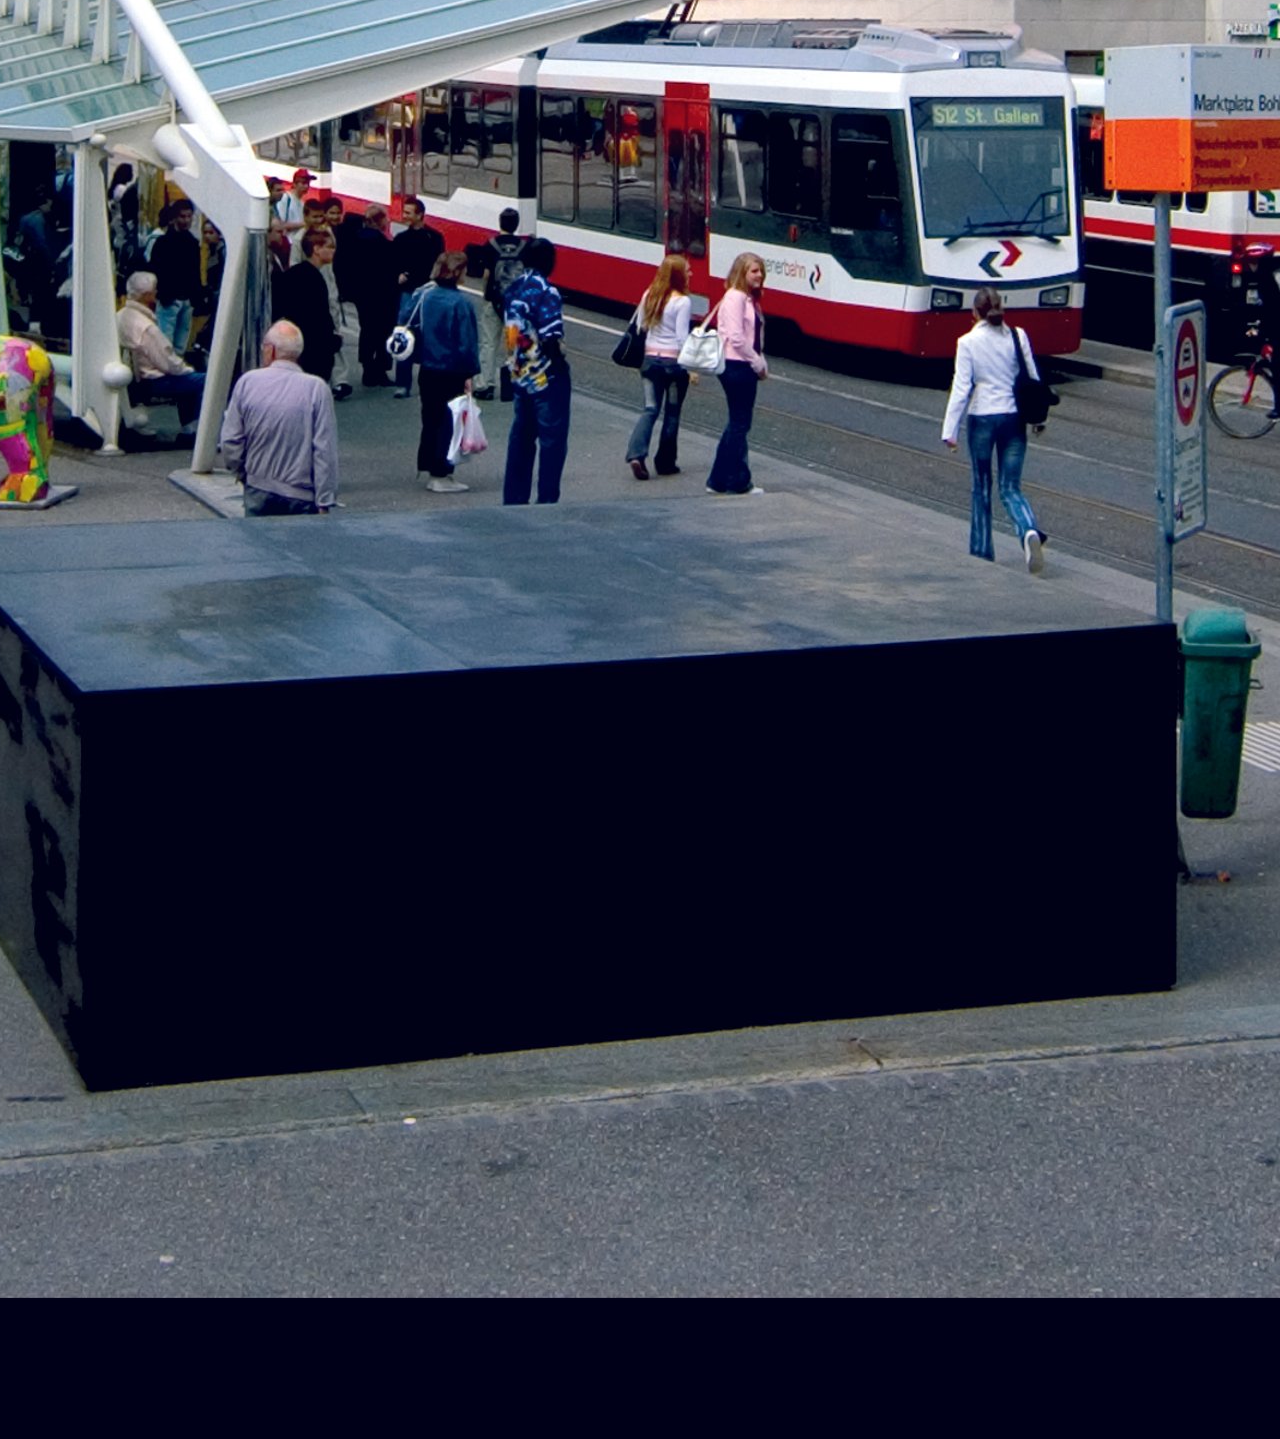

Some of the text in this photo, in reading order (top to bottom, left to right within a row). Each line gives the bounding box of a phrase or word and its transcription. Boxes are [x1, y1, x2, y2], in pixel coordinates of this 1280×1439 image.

[933, 104, 1040, 124] S12 St. Gallen
[1193, 93, 1254, 116] Marktplatz
